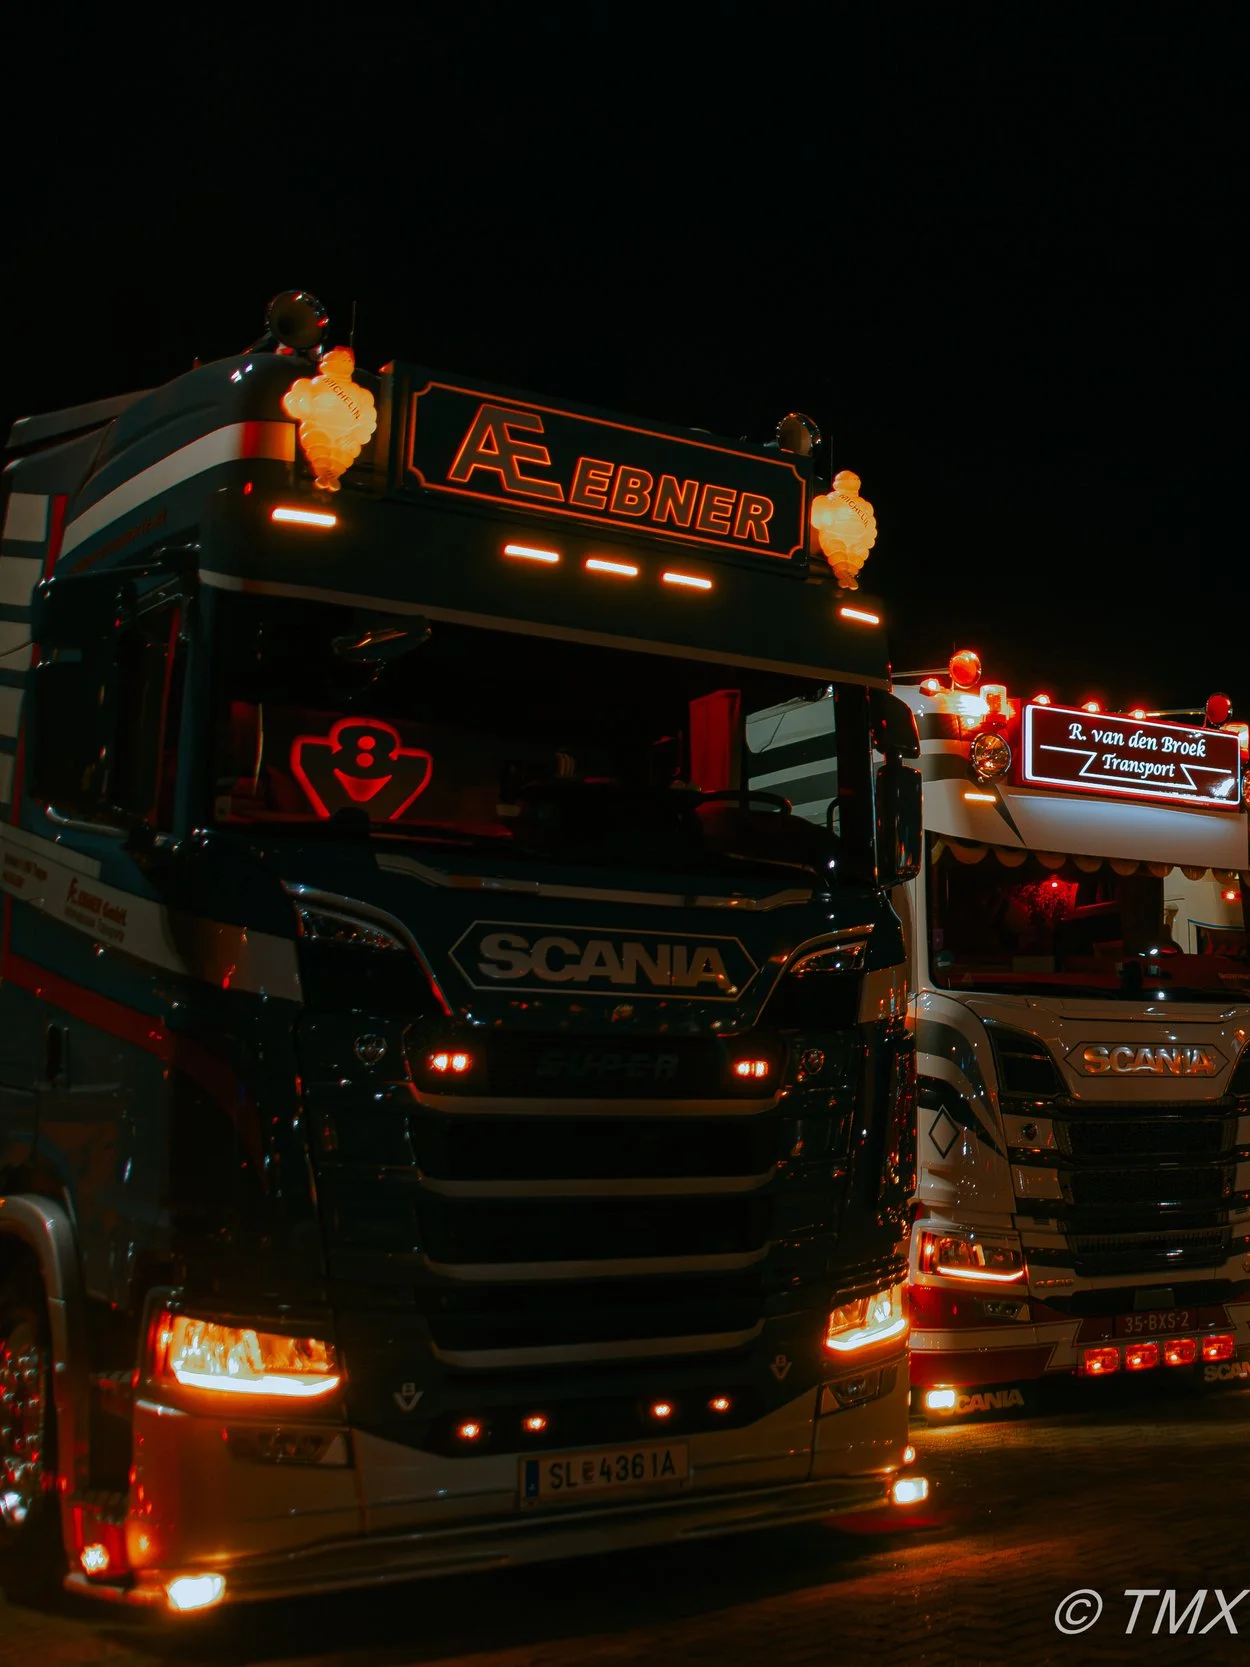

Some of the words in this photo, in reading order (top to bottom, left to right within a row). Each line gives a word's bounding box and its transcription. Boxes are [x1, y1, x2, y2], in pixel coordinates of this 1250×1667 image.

[324, 377, 361, 420] MICHELIN
[568, 455, 775, 544] EBNER
[1068, 723, 1088, 741] R.
[1091, 729, 1124, 747] van
[1128, 730, 1158, 750] den
[1161, 736, 1207, 758] Broek
[1102, 753, 1176, 780] Transport
[477, 932, 736, 991] SCANIA
[535, 1052, 680, 1080] SUPER
[1082, 1046, 1213, 1075] SCANIA
[956, 1388, 1025, 1414] CANIA
[549, 1461, 578, 1489] SL
